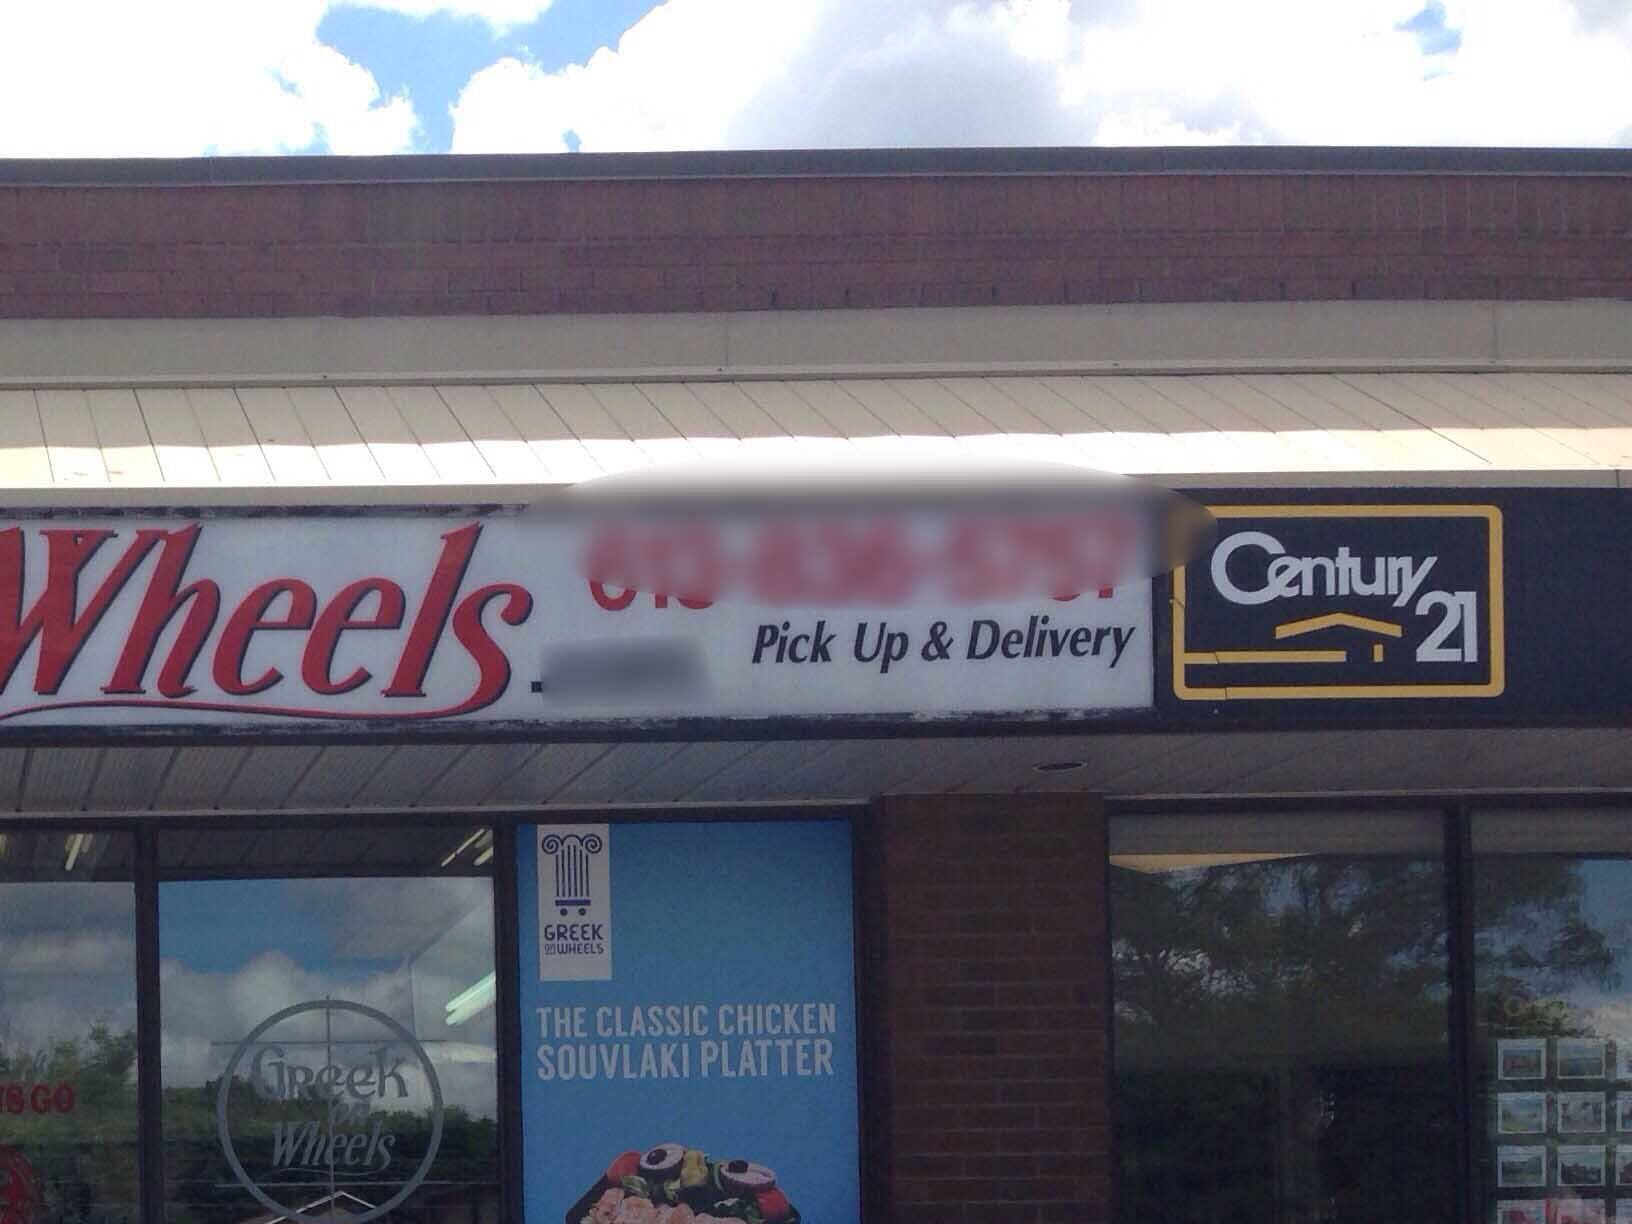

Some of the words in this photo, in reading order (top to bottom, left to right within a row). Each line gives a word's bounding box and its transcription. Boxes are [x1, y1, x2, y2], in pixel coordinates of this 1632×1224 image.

[1211, 531, 1438, 607] Century
[752, 618, 837, 664] Pick
[853, 620, 909, 673] Up
[920, 620, 955, 662] &
[967, 615, 1136, 669] Delivery
[1415, 591, 1478, 662] 21
[544, 924, 604, 941] GREEK
[557, 943, 604, 954] WHEELS
[536, 1006, 587, 1038] THE
[596, 1004, 709, 1037] CLASSIC
[718, 1003, 837, 1035] CHICKEN
[537, 1042, 690, 1081] SOUVLAKI
[700, 1039, 835, 1078] PLATTER
[270, 1119, 397, 1172] Wheels
